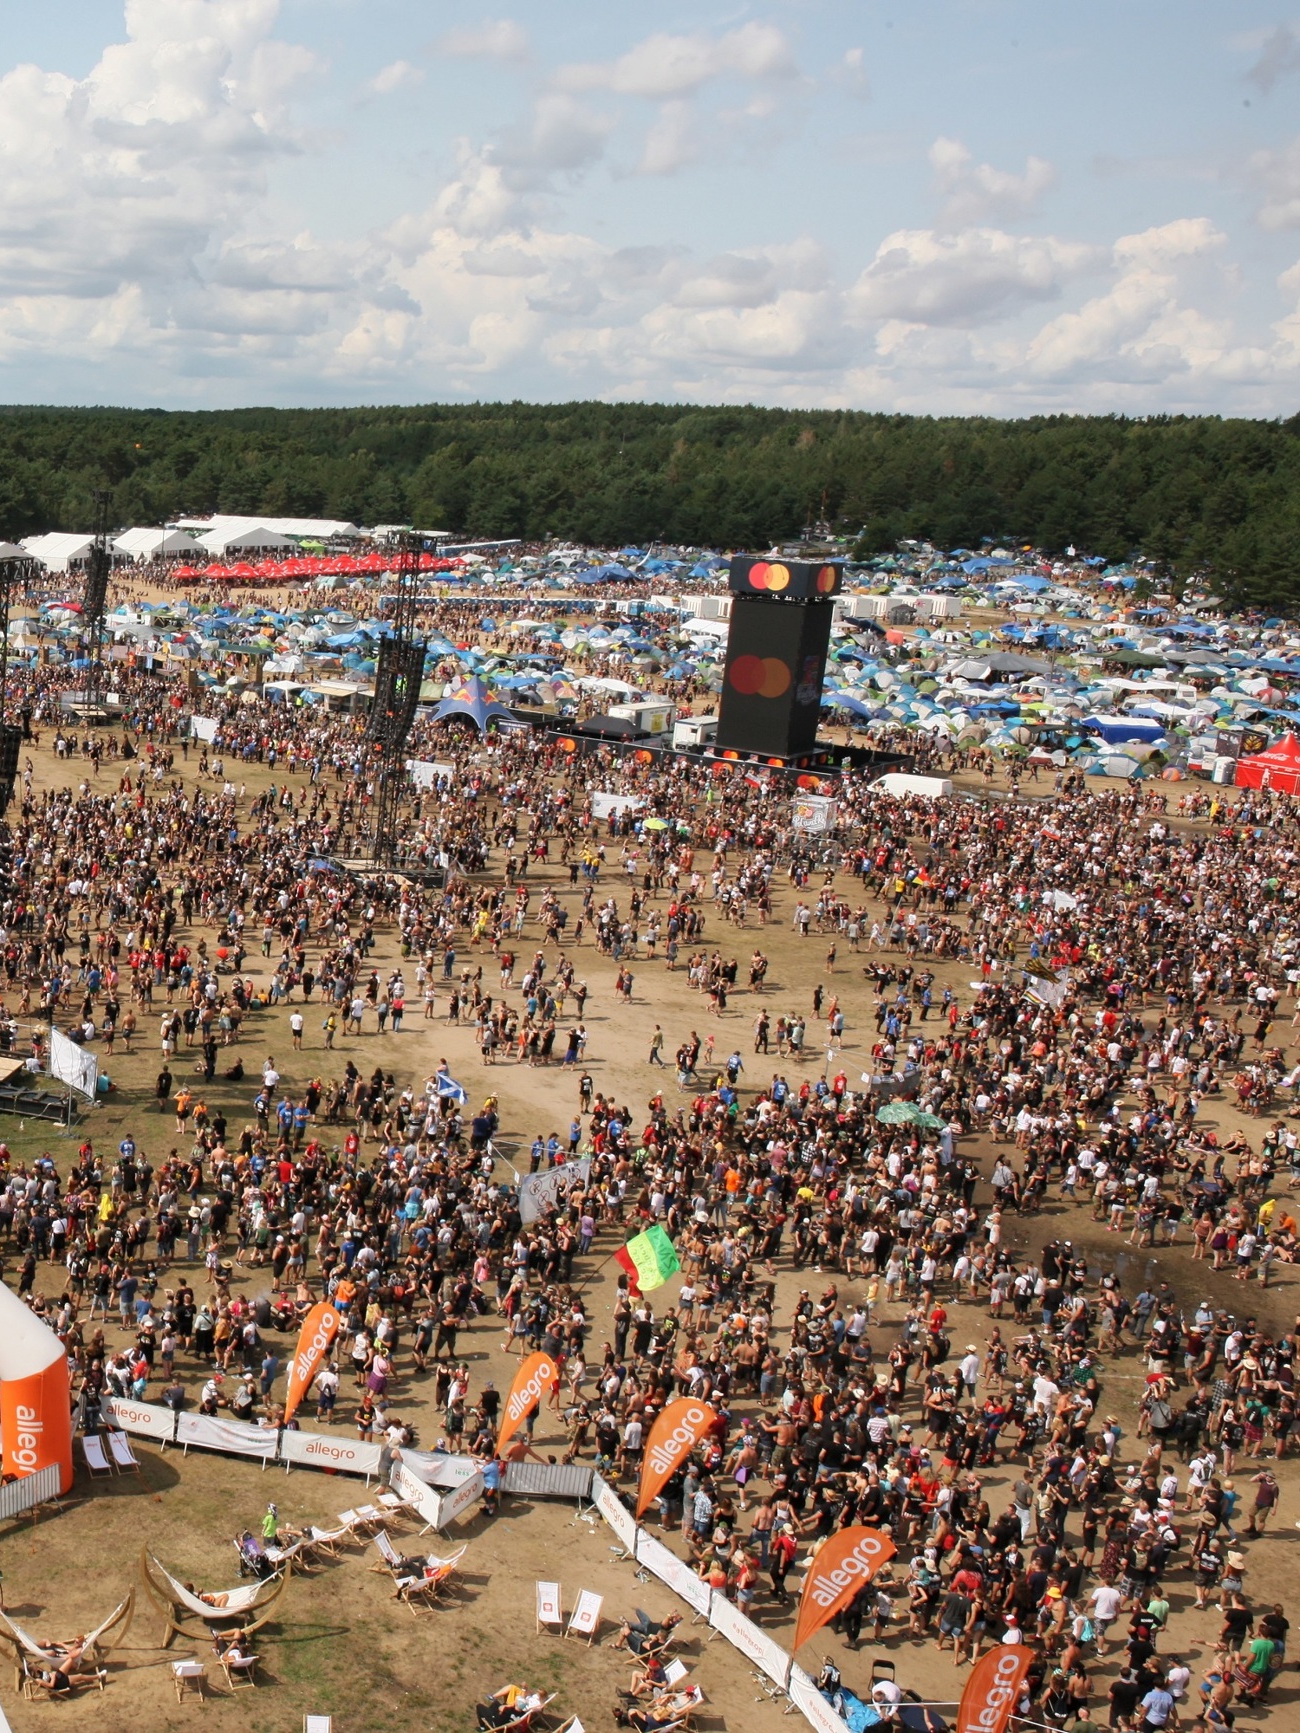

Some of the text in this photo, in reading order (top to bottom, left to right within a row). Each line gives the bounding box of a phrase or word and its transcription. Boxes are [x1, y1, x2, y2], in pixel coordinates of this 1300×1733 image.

[296, 1312, 334, 1381] allegro
[106, 1405, 151, 1423] allegro
[508, 1363, 551, 1421] allegro
[12, 1405, 44, 1473] allegr
[305, 1442, 355, 1460] allegro
[650, 1408, 705, 1475] allegro
[395, 1470, 424, 1502] allegro
[452, 1483, 478, 1508] allegro
[602, 1495, 625, 1527] allegro
[811, 1537, 882, 1607] allegro
[964, 1654, 1020, 1733] legro
